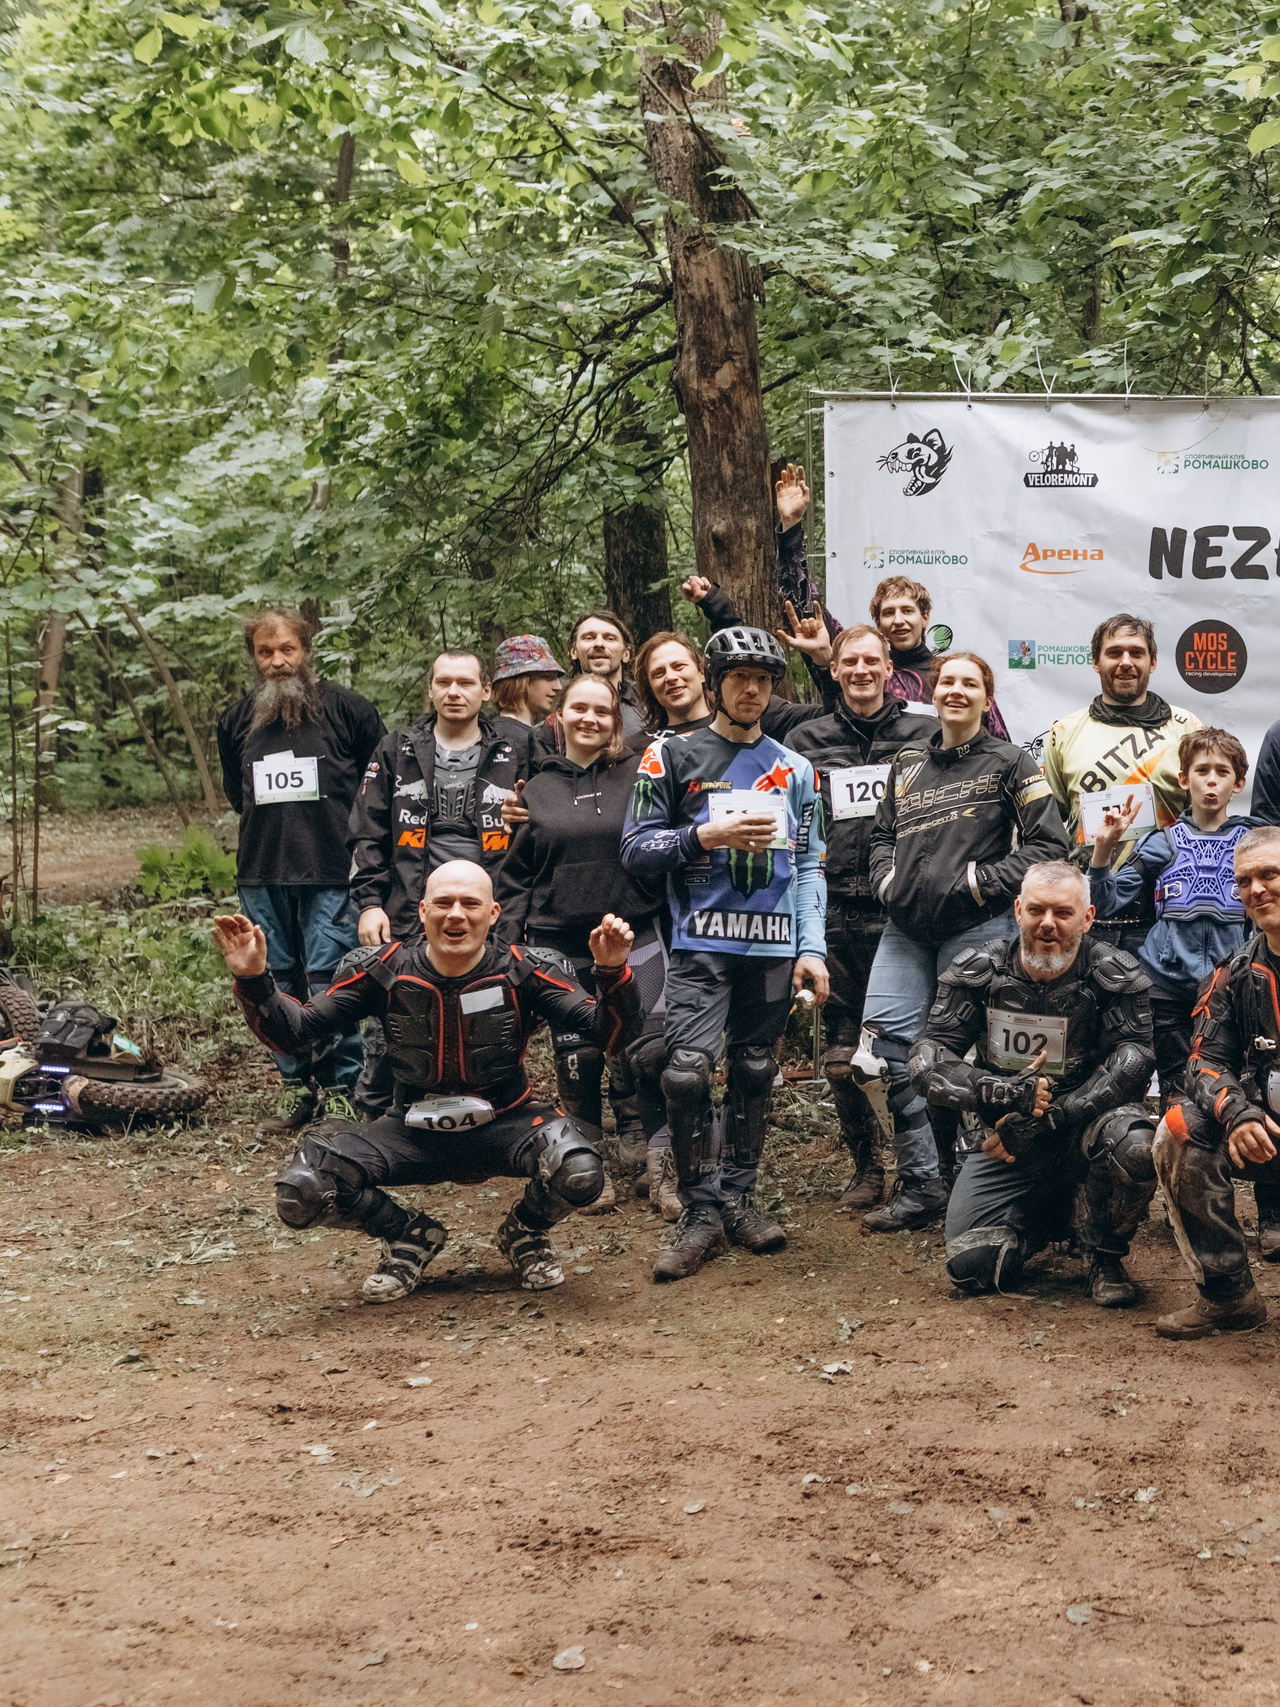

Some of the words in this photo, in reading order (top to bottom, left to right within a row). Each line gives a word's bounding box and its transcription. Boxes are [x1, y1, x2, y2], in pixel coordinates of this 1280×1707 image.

[1184, 460, 1269, 470] РОМАШКОВО
[1027, 473, 1095, 486] VELOREMONT
[888, 555, 968, 565] РОМАШКОВО
[1021, 542, 1104, 561] Арена
[1193, 632, 1228, 651] MOS
[1185, 651, 1237, 669] CYCLE
[1079, 728, 1166, 793] BITZA
[265, 771, 304, 790] 105
[846, 780, 886, 803] 120
[481, 814, 504, 828] Bu
[693, 910, 791, 942] YAMAHA
[1002, 1027, 1048, 1056] 102
[423, 1112, 478, 1130] 104
